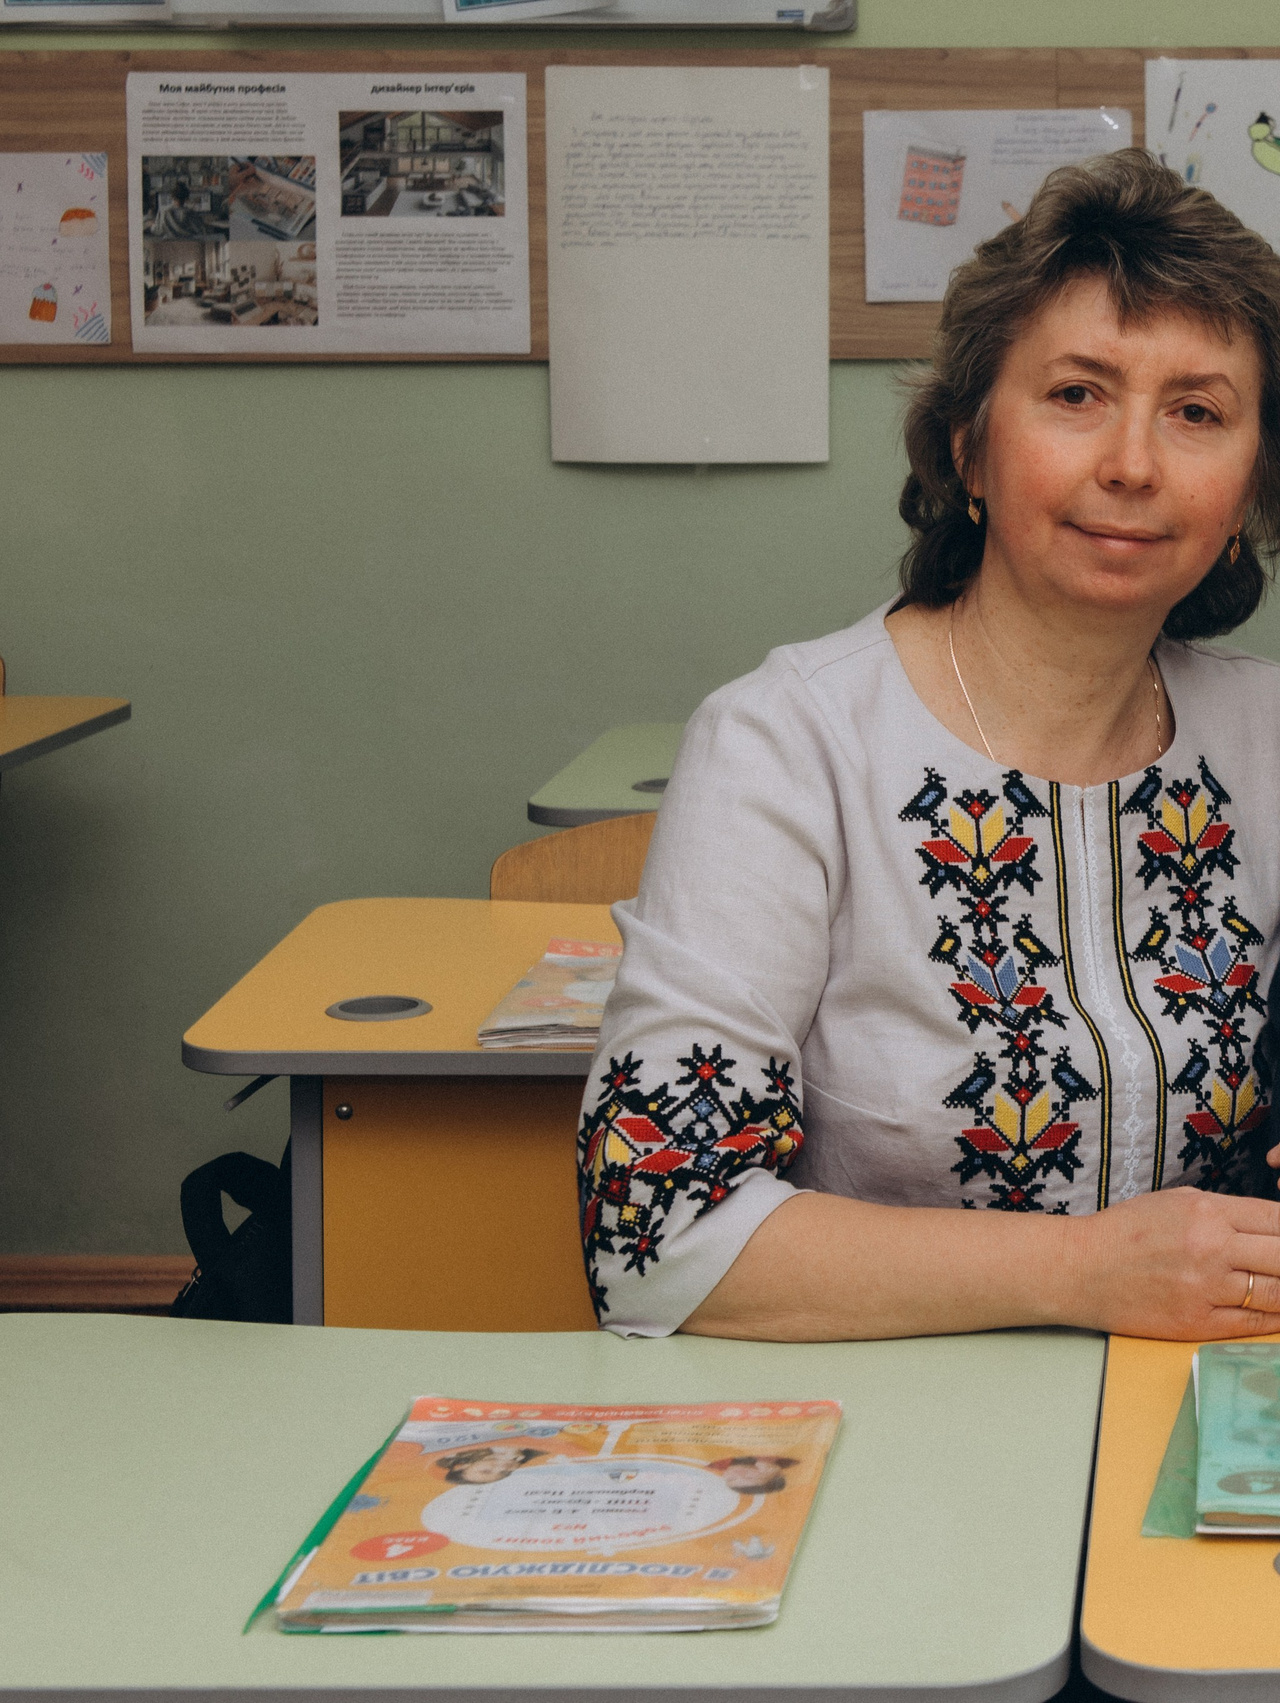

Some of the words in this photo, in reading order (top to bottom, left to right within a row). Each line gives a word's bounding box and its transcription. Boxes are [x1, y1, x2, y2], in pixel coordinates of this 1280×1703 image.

[159, 83, 182, 92] Моя
[185, 82, 235, 94] майбутня
[238, 82, 286, 95] професія
[371, 82, 422, 95] дизайнер
[1249, 1482, 1273, 1493] 4
[384, 1544, 415, 1559] 4
[350, 1567, 439, 1586] СВІТ
[447, 1562, 701, 1579] ДОСЛІДЖУЮ
[704, 1568, 734, 1581] Я
